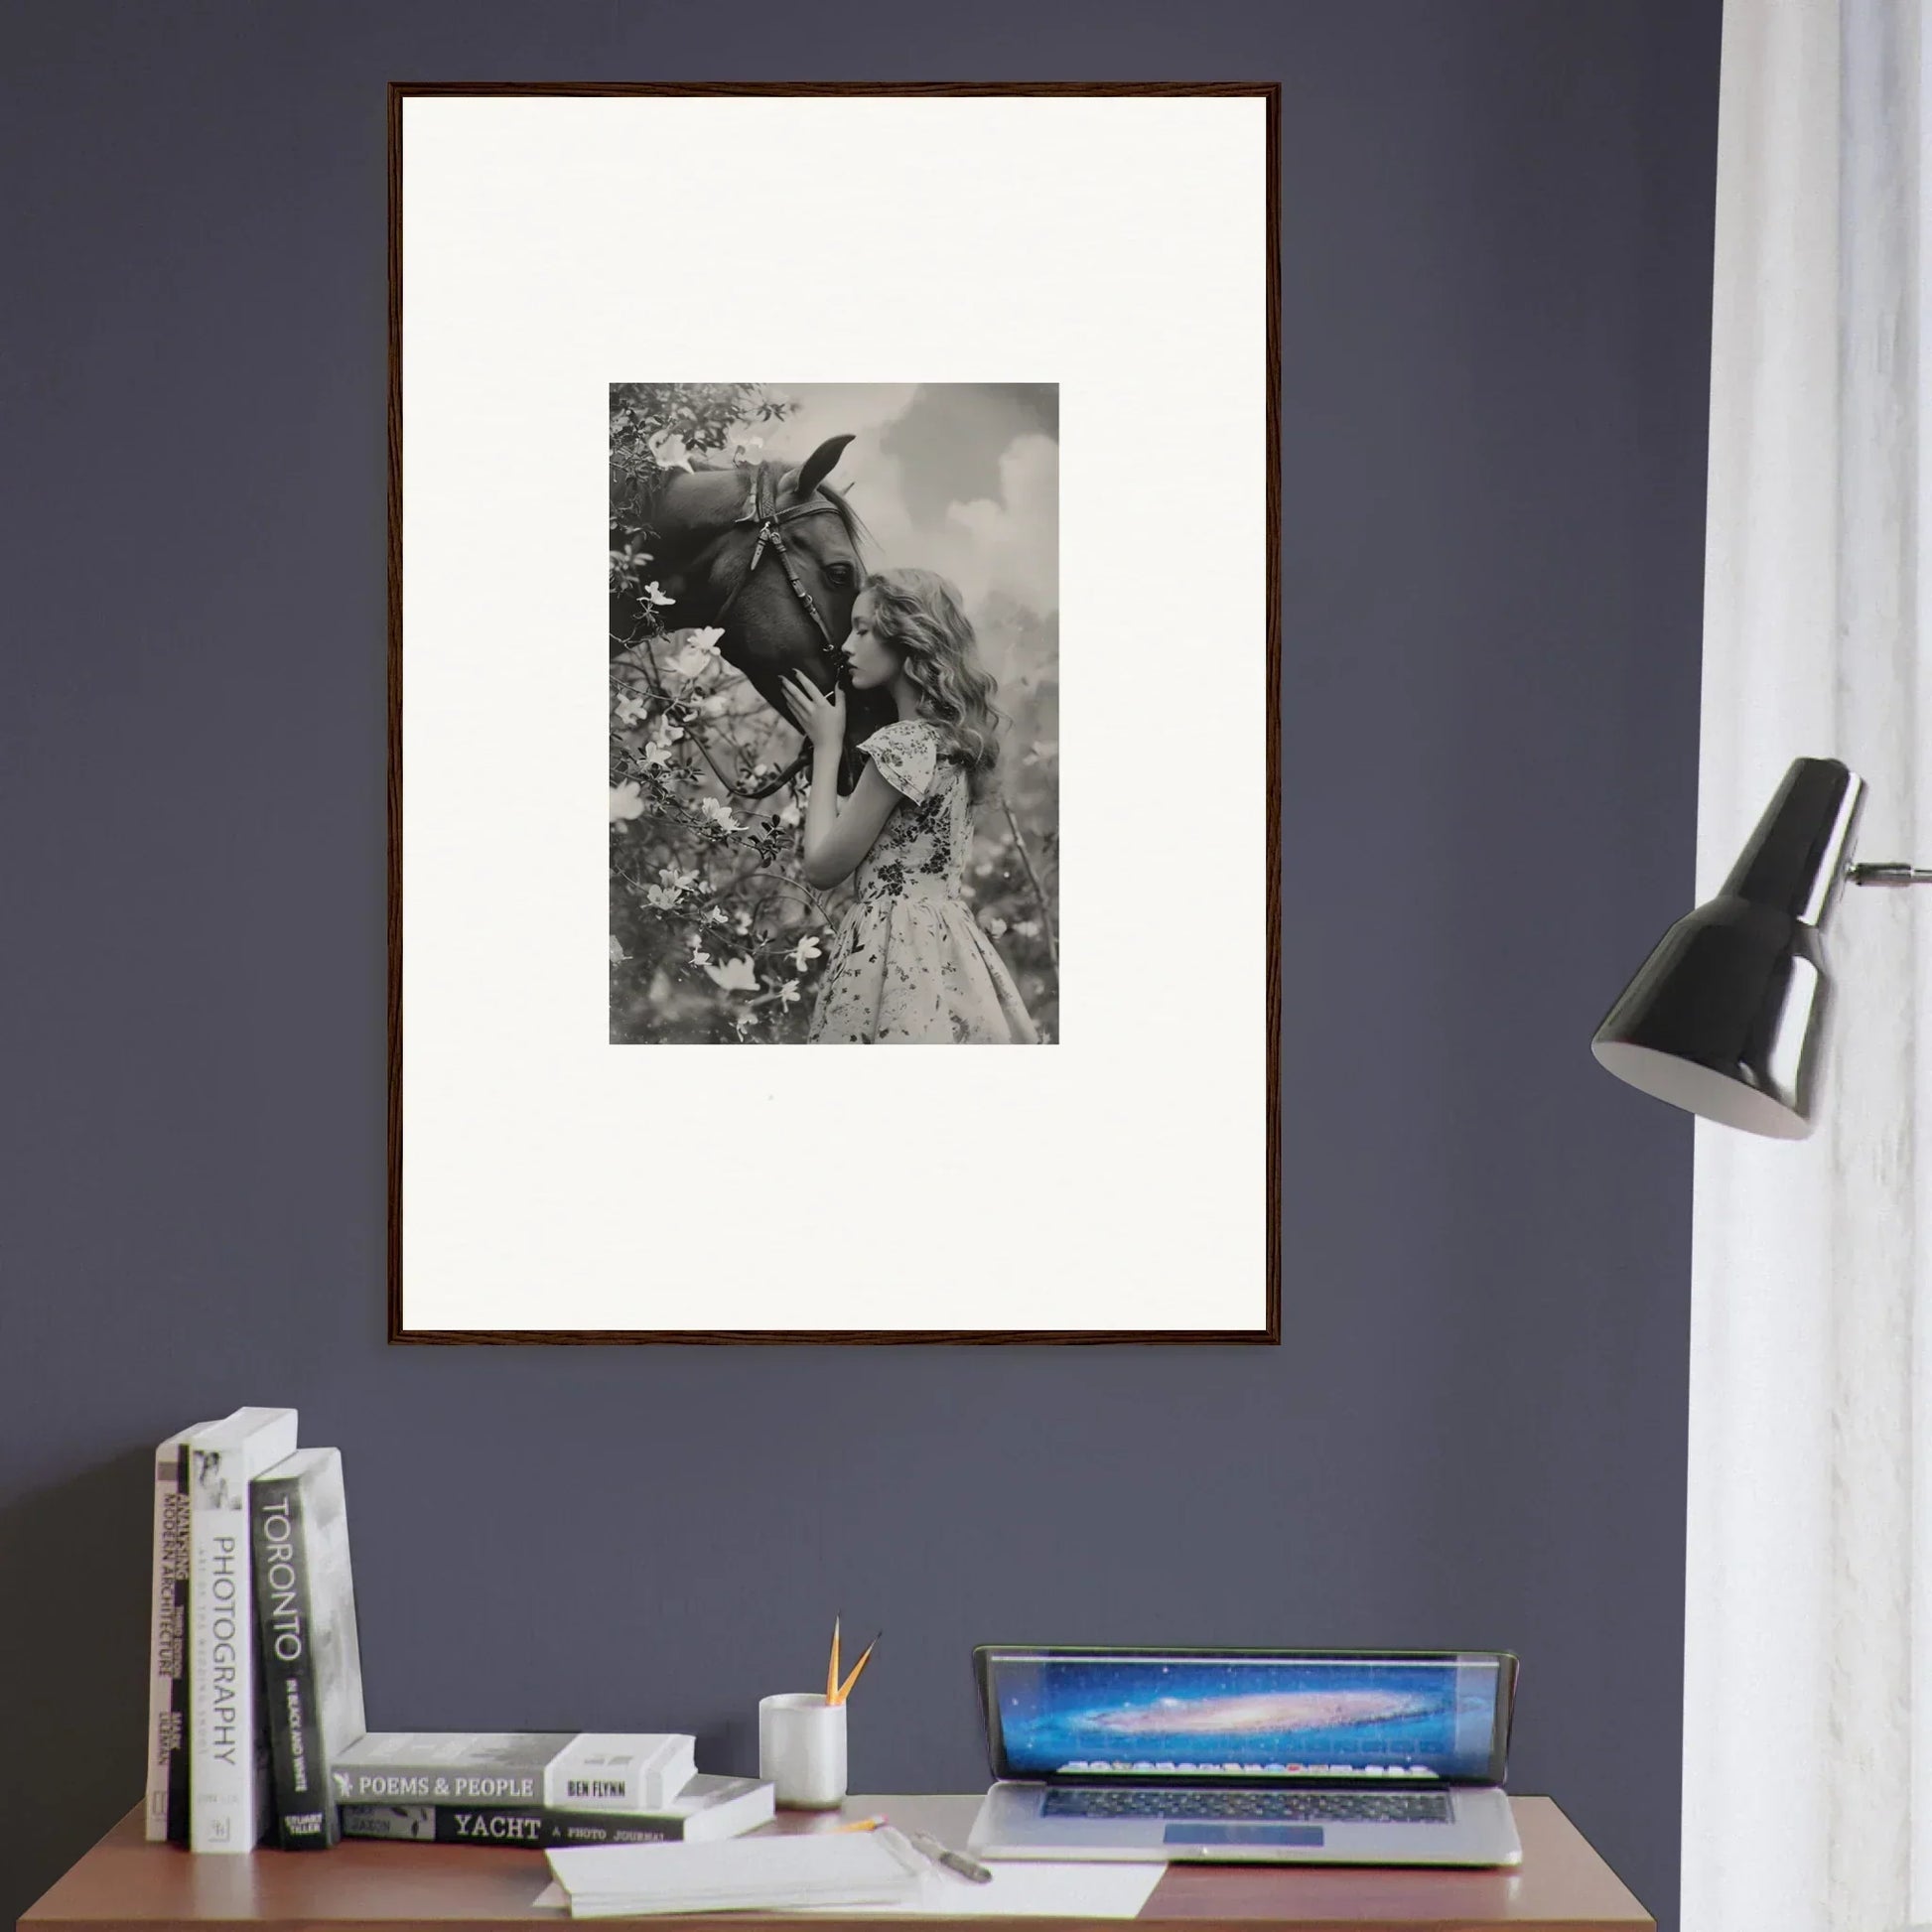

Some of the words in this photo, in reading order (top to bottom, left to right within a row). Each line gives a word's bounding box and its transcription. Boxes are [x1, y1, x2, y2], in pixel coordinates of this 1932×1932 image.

[163, 1493, 176, 1560] MODERN
[261, 1498, 303, 1662] TORONTO
[159, 1566, 174, 1678] ARCHITECTURE
[212, 1537, 236, 1766] PHOTOGRAPHY
[359, 1777, 430, 1795] POEMS
[435, 1778, 451, 1795] &
[455, 1777, 534, 1797] PEOPLE
[568, 1780, 589, 1797] BEN
[593, 1780, 625, 1797] FLYNN
[455, 1813, 541, 1840] YACHT
[552, 1827, 561, 1837] A
[568, 1827, 606, 1840] PHOTO
